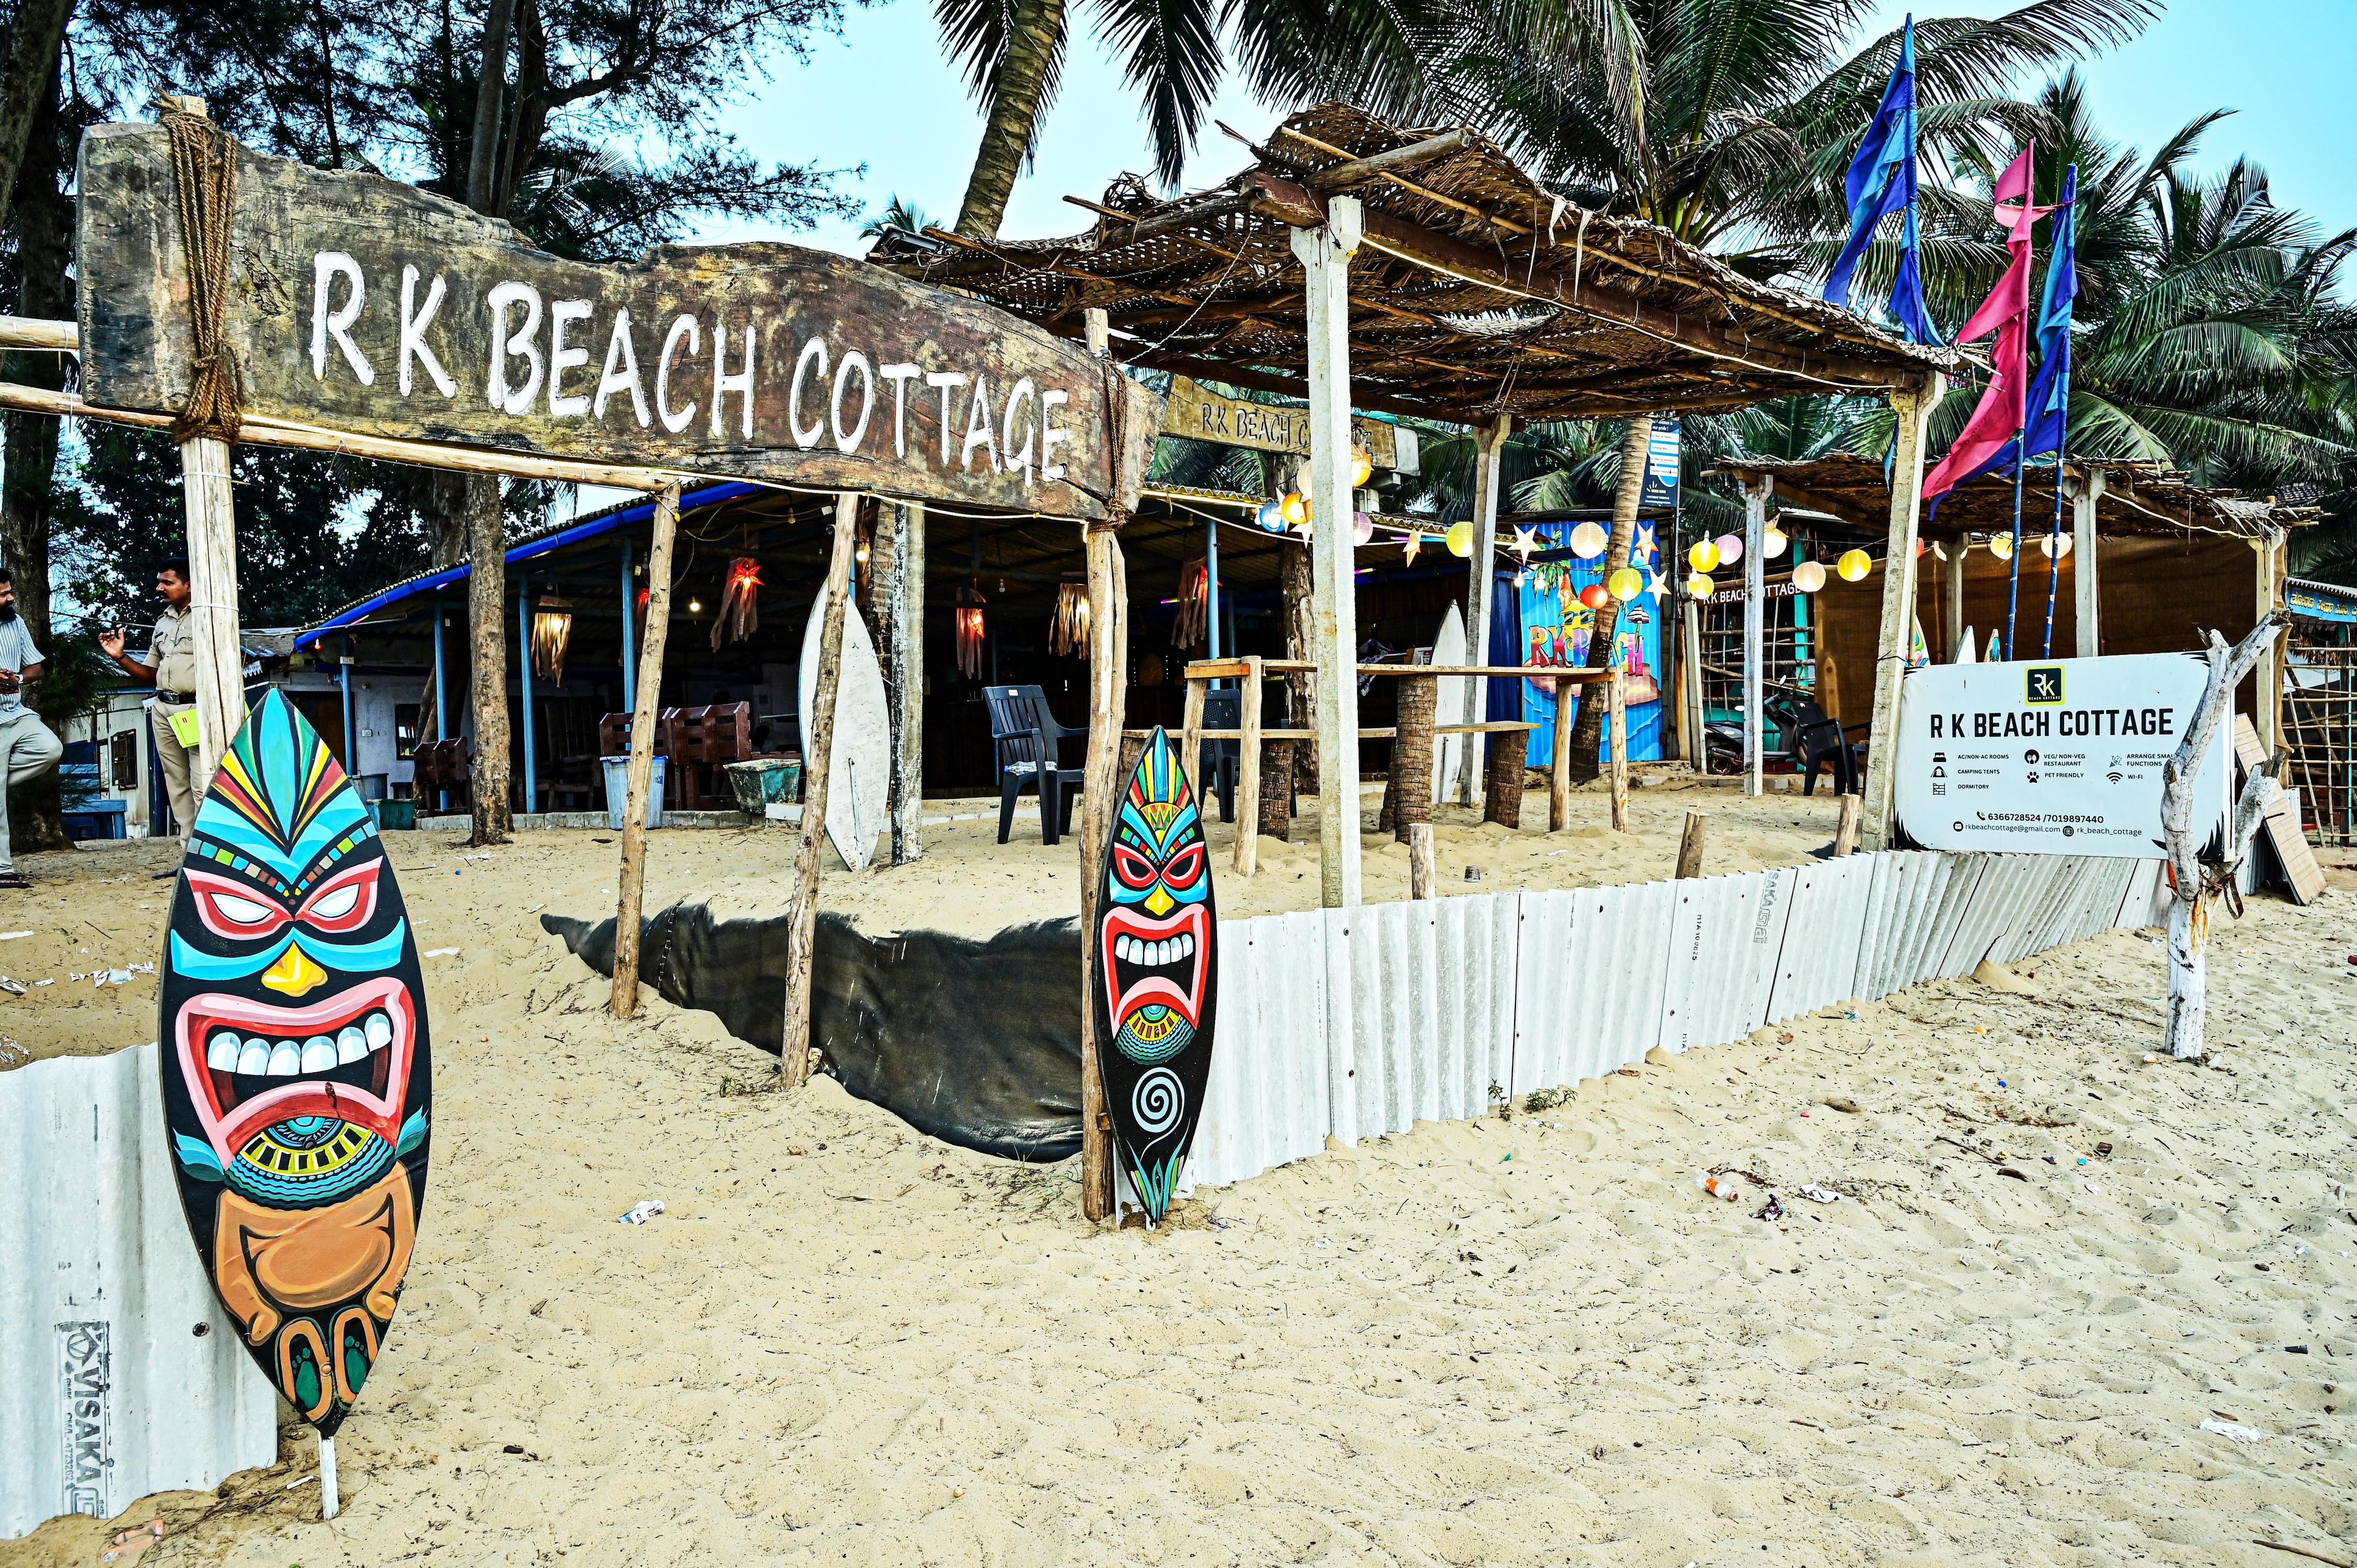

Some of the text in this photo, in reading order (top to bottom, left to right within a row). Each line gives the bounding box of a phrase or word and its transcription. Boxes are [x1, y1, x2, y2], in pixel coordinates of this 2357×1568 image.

[486, 280, 756, 439] BEACH
[788, 336, 1070, 488] COTTAGE
[1236, 408, 1291, 447] BEACH
[1720, 589, 1746, 603] BEACH
[1931, 708, 2173, 738] R K BEACH COTTAGE
[1965, 823, 2061, 833] rkbeachcottage@gmail.com
[1988, 813, 2104, 824] 6366728524 /7019897440
[2077, 827, 2142, 836] rk_beach_cottage
[74, 1367, 101, 1484] VISAKA
